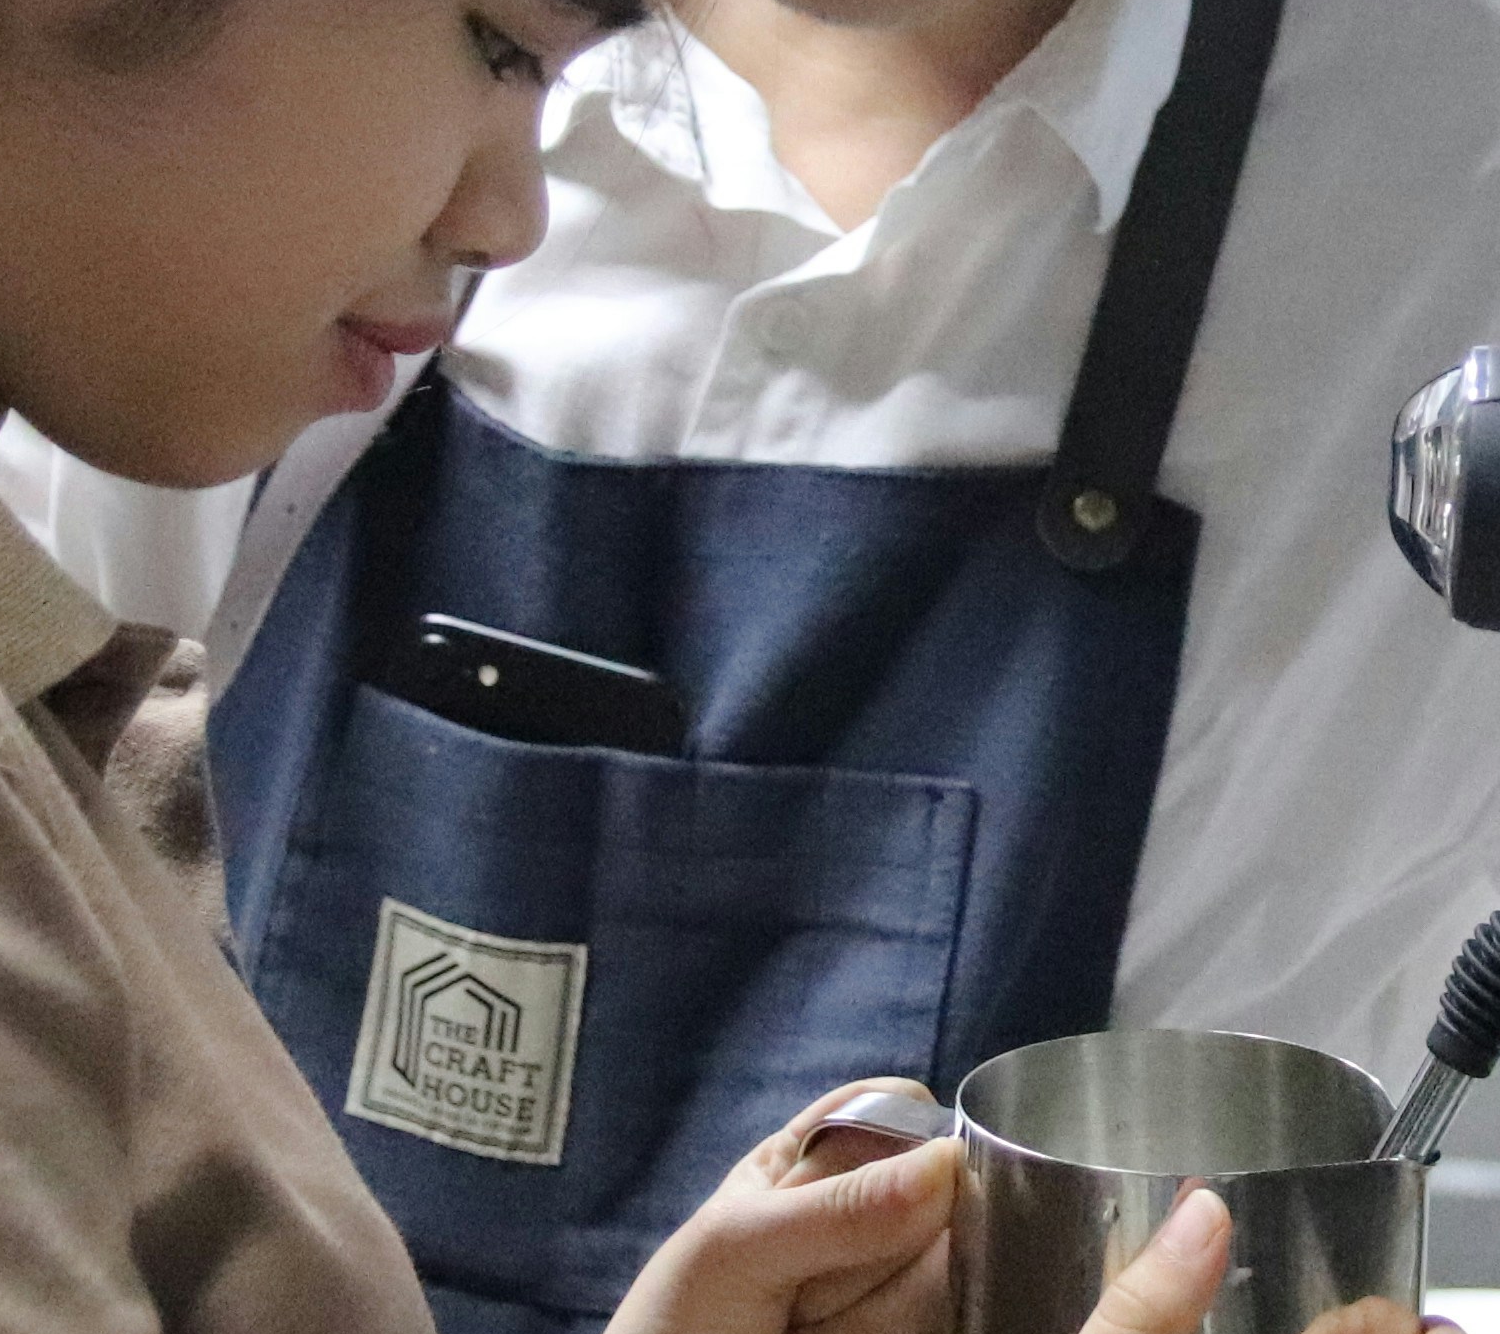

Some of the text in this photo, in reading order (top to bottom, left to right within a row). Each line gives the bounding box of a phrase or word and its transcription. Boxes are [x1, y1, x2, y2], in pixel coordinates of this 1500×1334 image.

[431, 1016, 479, 1044] THE
[425, 1043, 543, 1087] CRAFT
[422, 1075, 536, 1122] HOUSE
